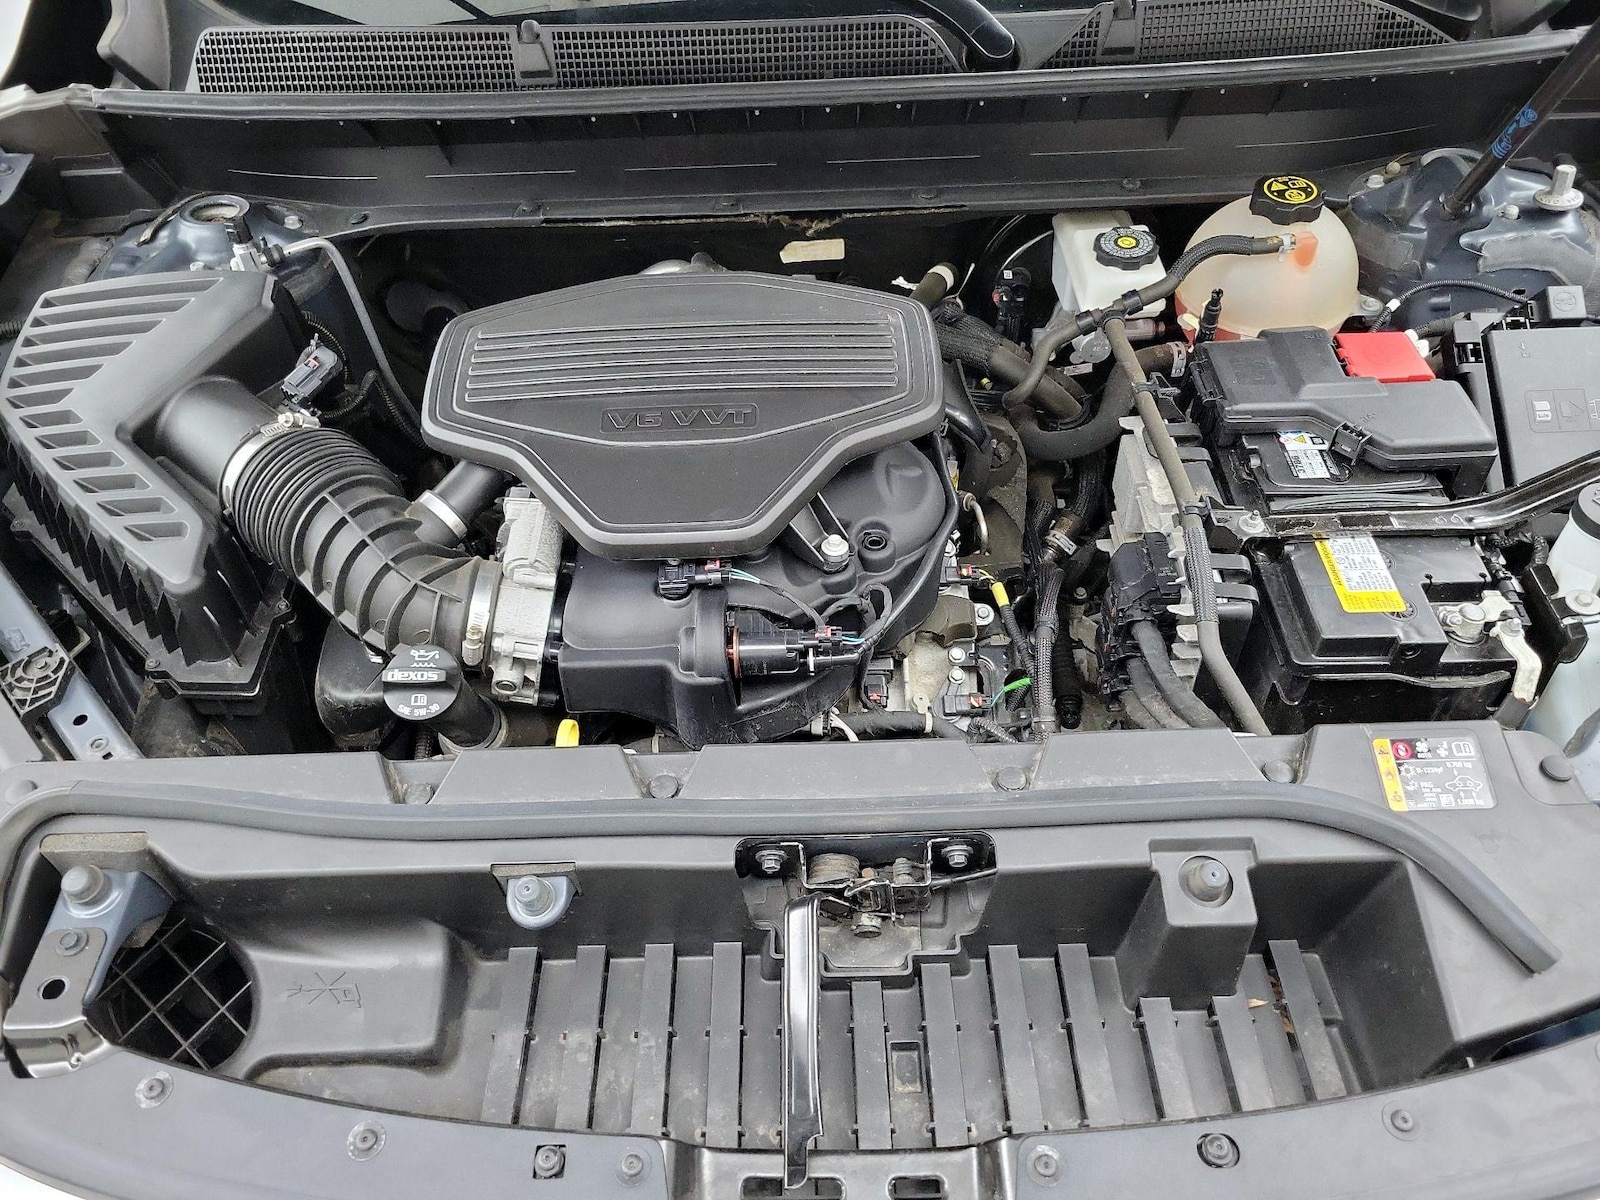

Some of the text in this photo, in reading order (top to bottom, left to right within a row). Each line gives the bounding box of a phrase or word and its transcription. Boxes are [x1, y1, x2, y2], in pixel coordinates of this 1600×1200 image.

[607, 408, 752, 429] V6 VVT
[387, 669, 441, 681] dexos
[397, 703, 440, 717] SAE 5W-30
